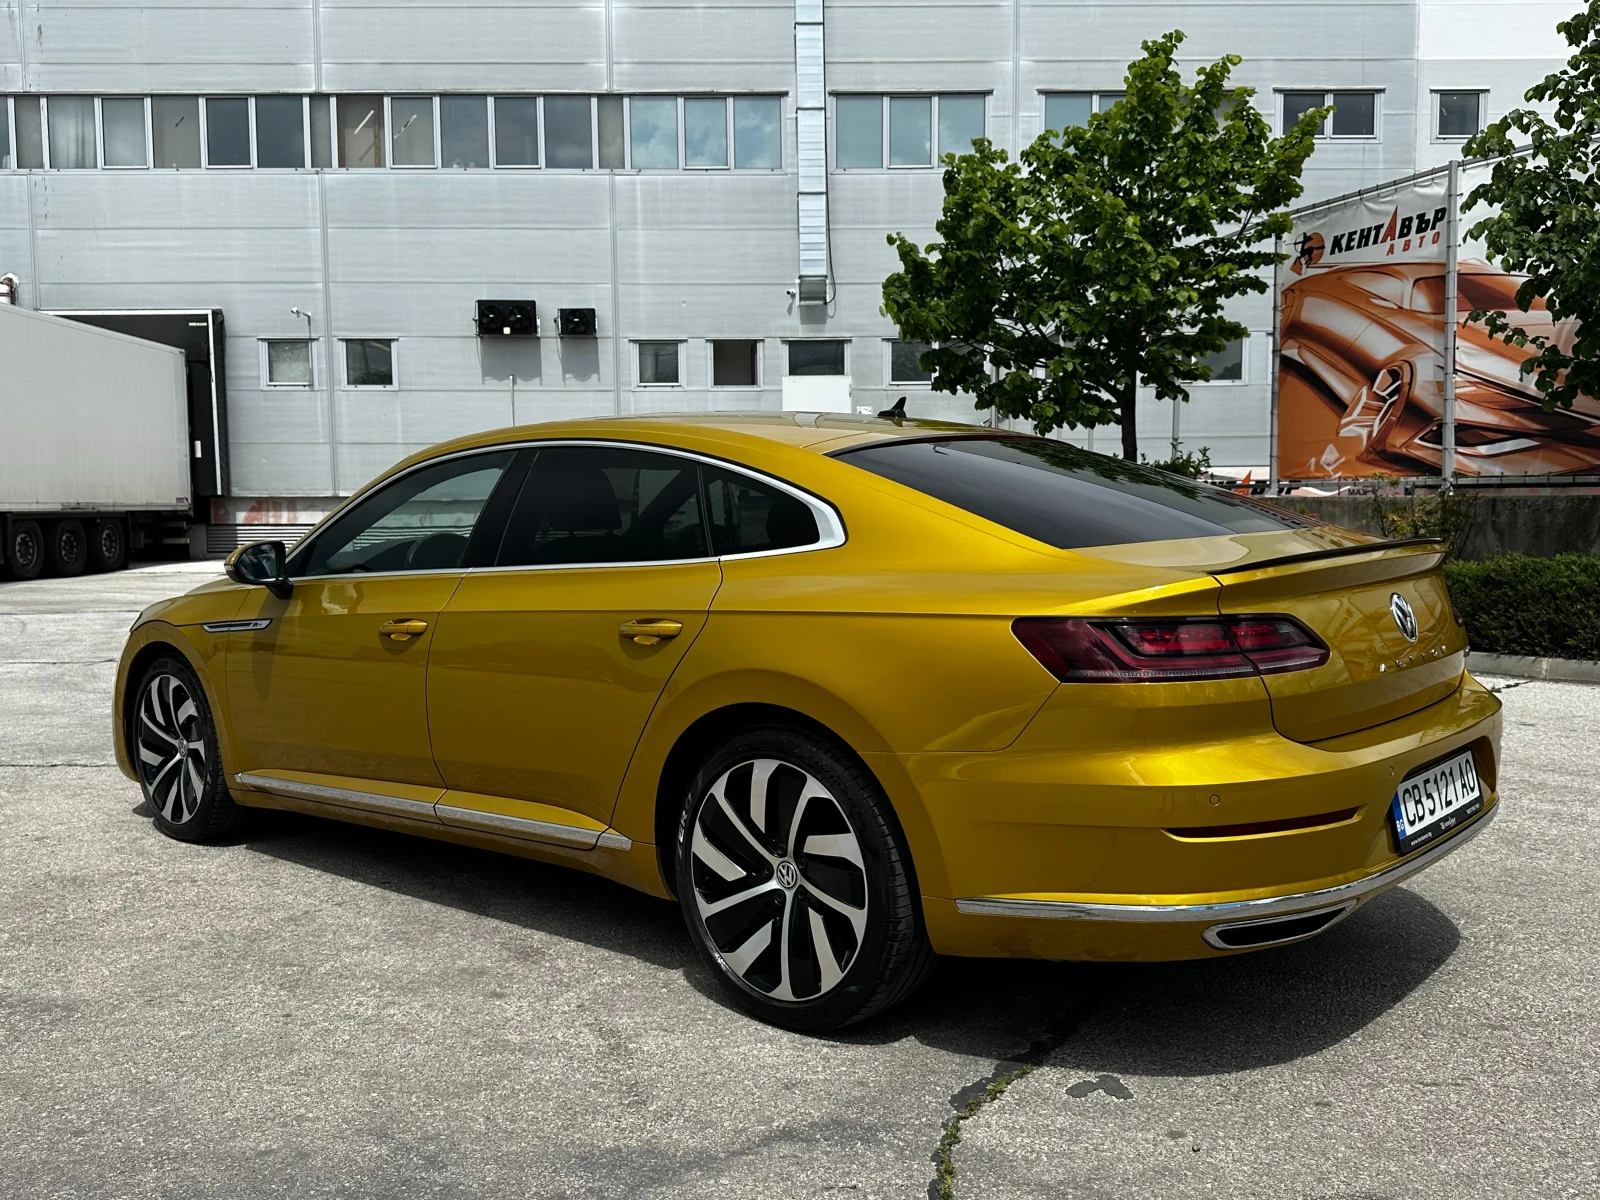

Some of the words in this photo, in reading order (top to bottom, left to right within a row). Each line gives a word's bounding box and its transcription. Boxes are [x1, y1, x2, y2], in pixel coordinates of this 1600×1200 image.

[1329, 205, 1447, 255] КЕНТАВЪР
[1386, 231, 1440, 256] АВТО
[1396, 819, 1405, 832] BG
